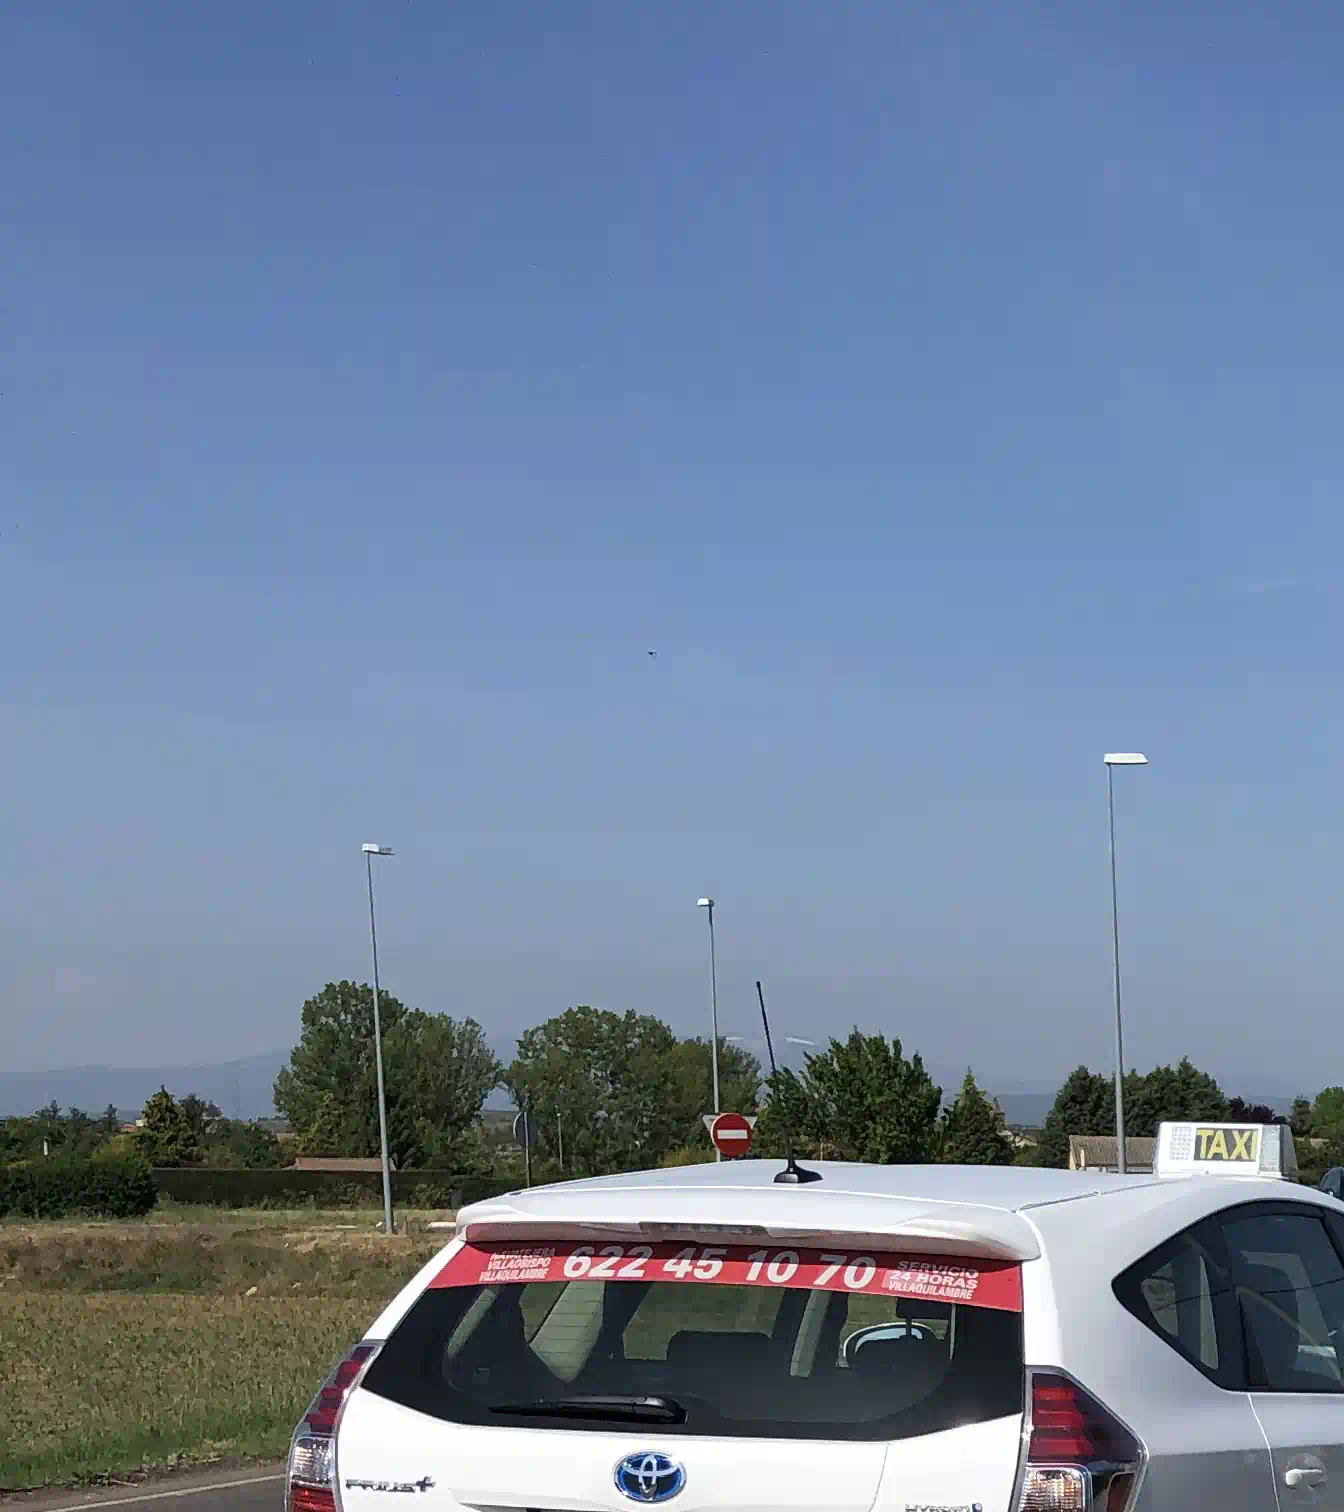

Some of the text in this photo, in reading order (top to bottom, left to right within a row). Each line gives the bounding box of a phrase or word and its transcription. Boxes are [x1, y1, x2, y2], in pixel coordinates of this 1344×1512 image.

[1196, 1129, 1258, 1160] TAXI
[563, 1246, 877, 1289] 622 45 10 70
[897, 1260, 979, 1279] SERVICIO
[888, 1280, 974, 1300] VILLAQUILAMBRE
[889, 1270, 978, 1290] 24 HORAS
